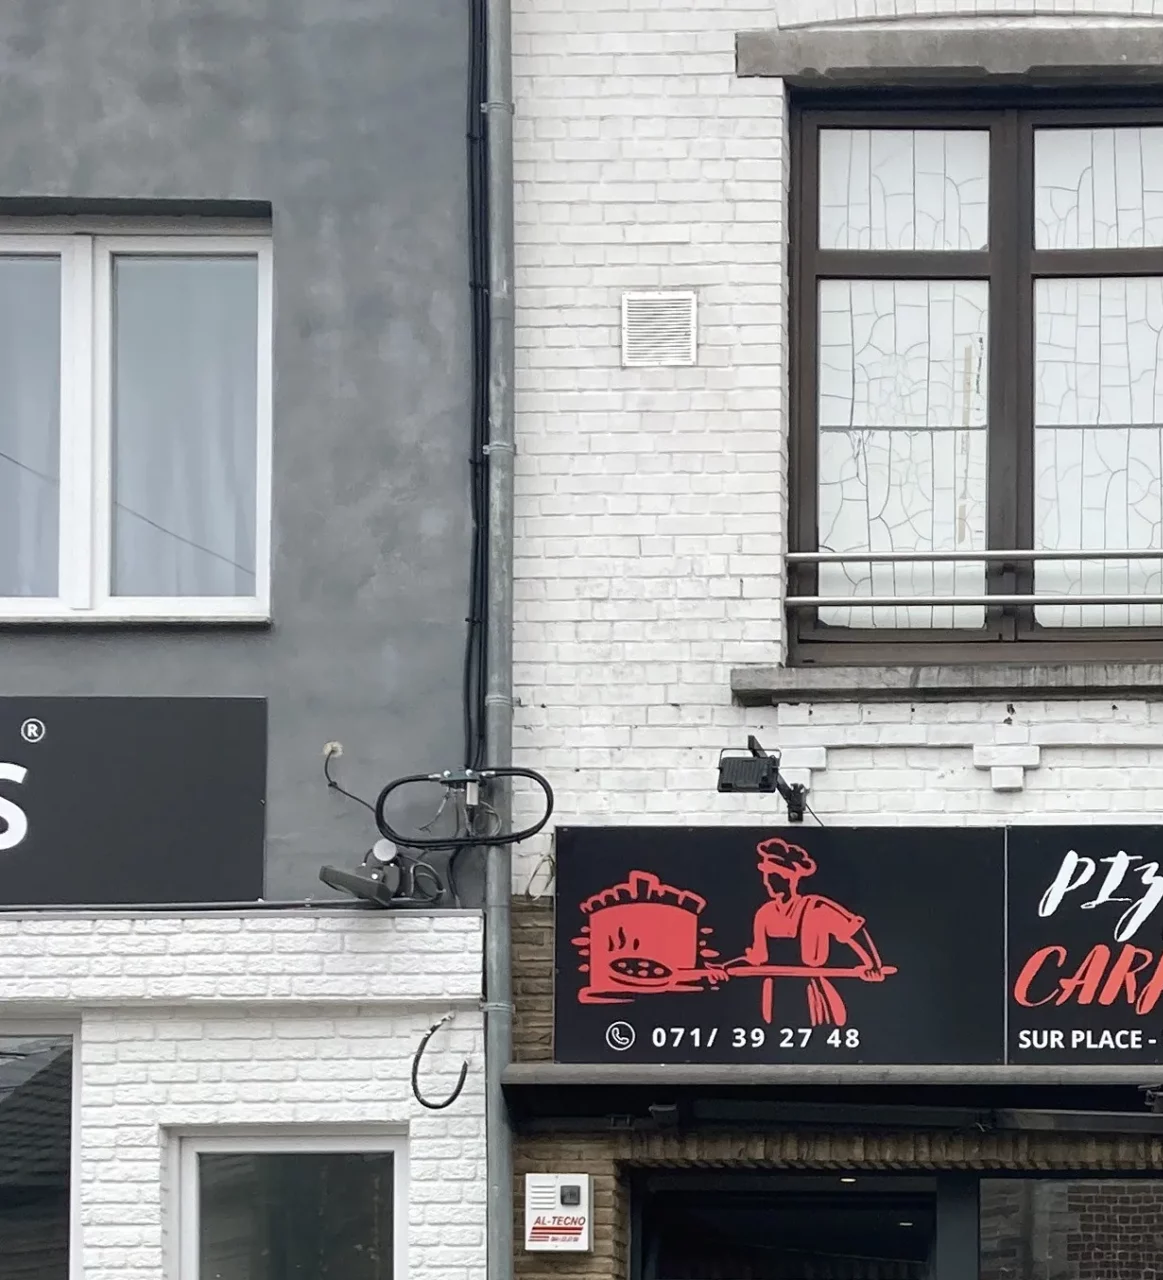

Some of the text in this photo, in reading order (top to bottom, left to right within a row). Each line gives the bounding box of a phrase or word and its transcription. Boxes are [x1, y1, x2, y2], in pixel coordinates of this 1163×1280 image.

[651, 1027, 861, 1048] 071/ 39 27 48
[1018, 1029, 1065, 1049] SUR
[1071, 1029, 1142, 1049] PLACE
[533, 1215, 587, 1226] AL-TECNO
